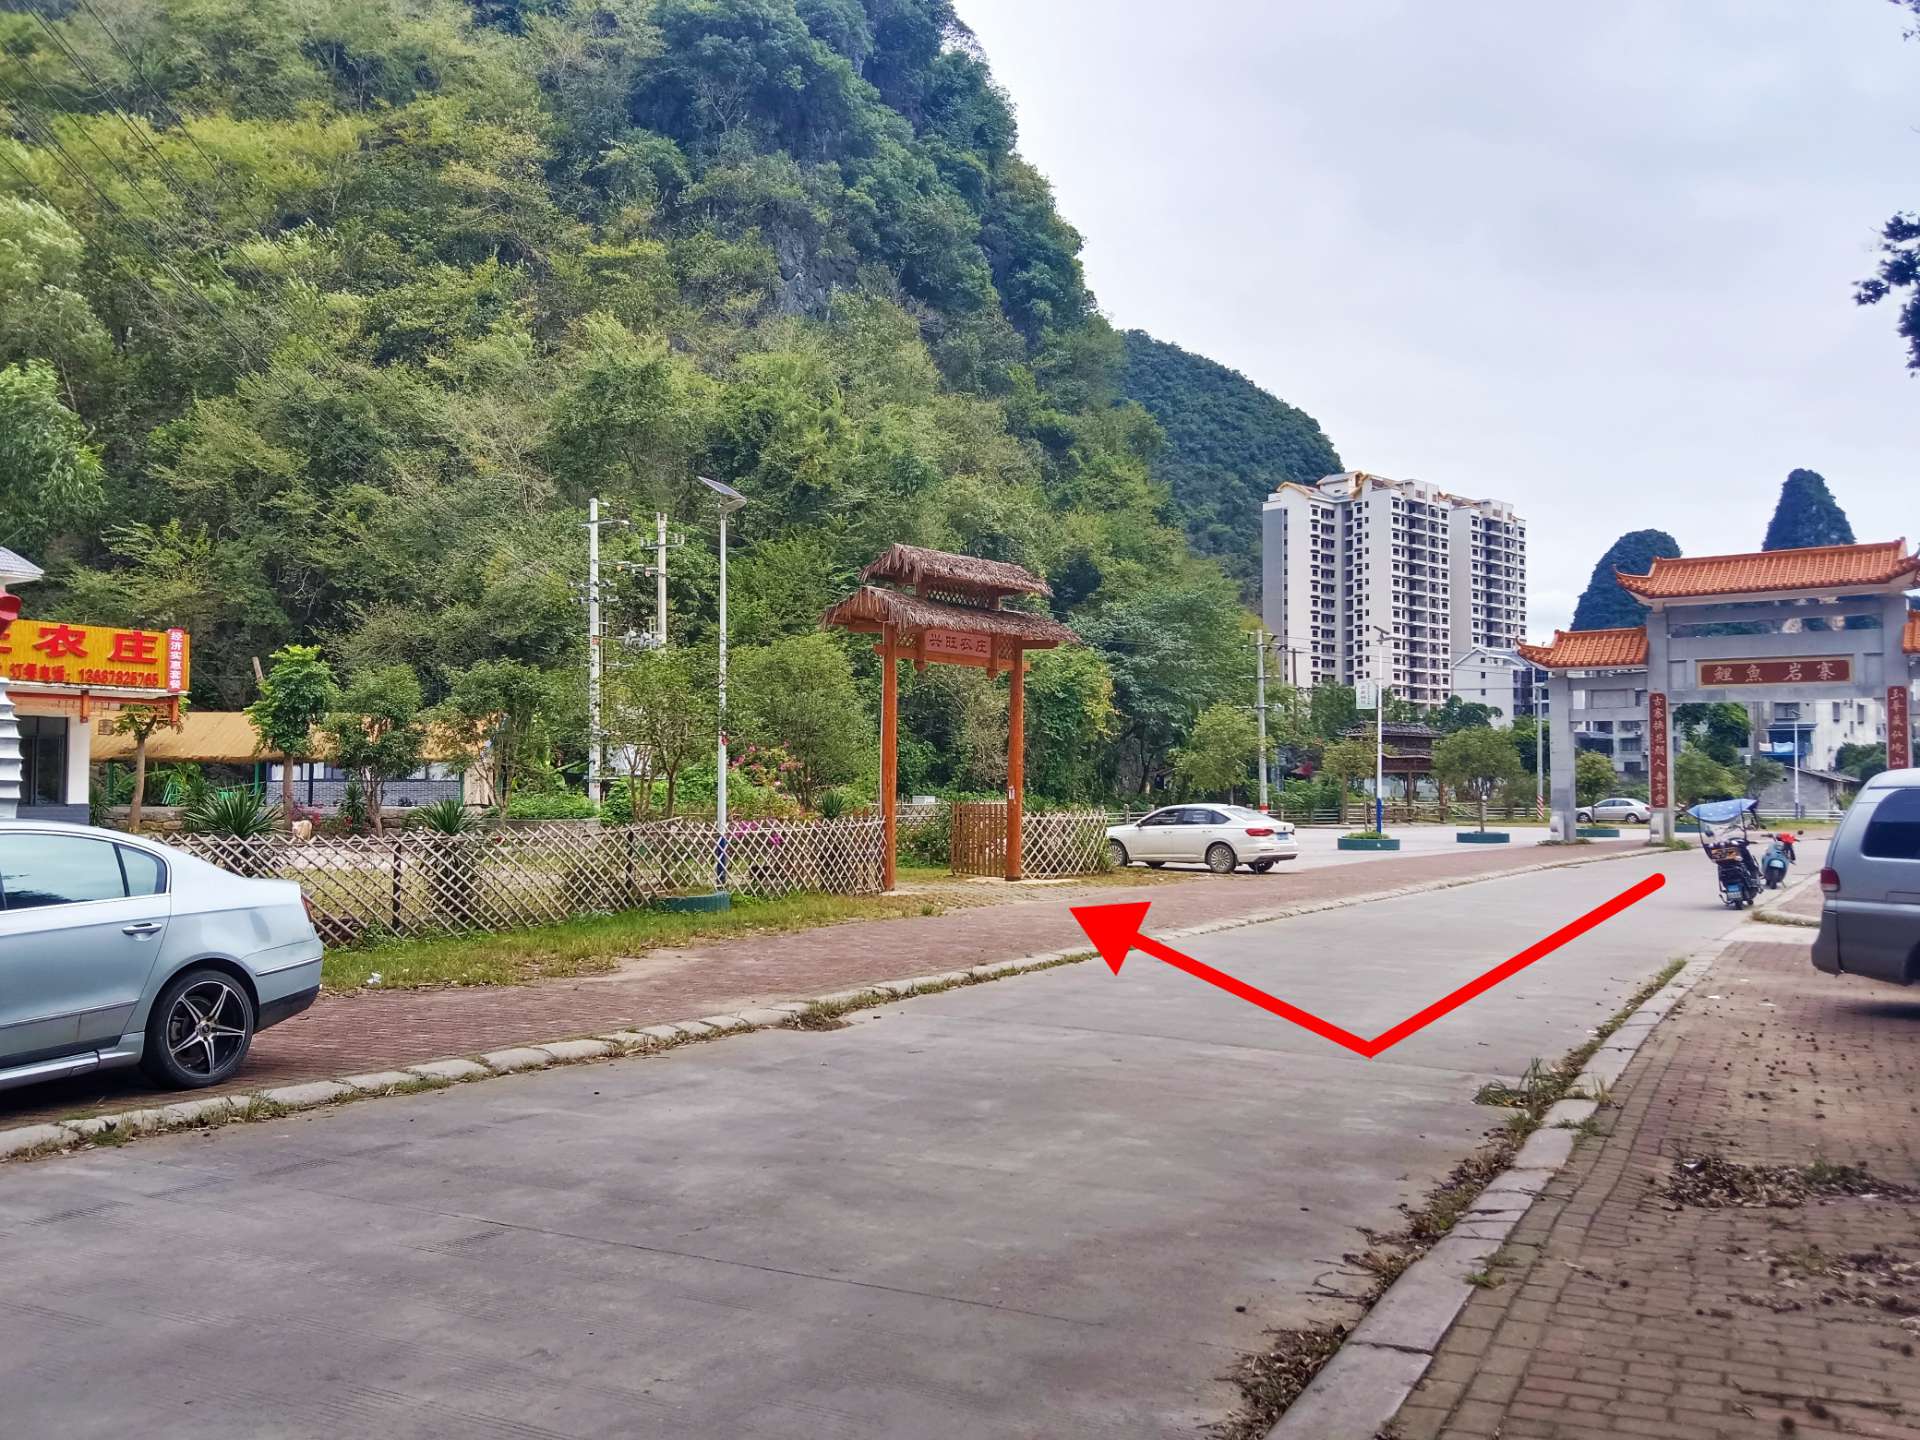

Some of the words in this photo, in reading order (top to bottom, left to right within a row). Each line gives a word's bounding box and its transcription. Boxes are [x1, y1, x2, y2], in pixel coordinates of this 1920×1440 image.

[169, 631, 183, 690] 经济实惠套餐
[929, 633, 987, 653] 兴旺农庄
